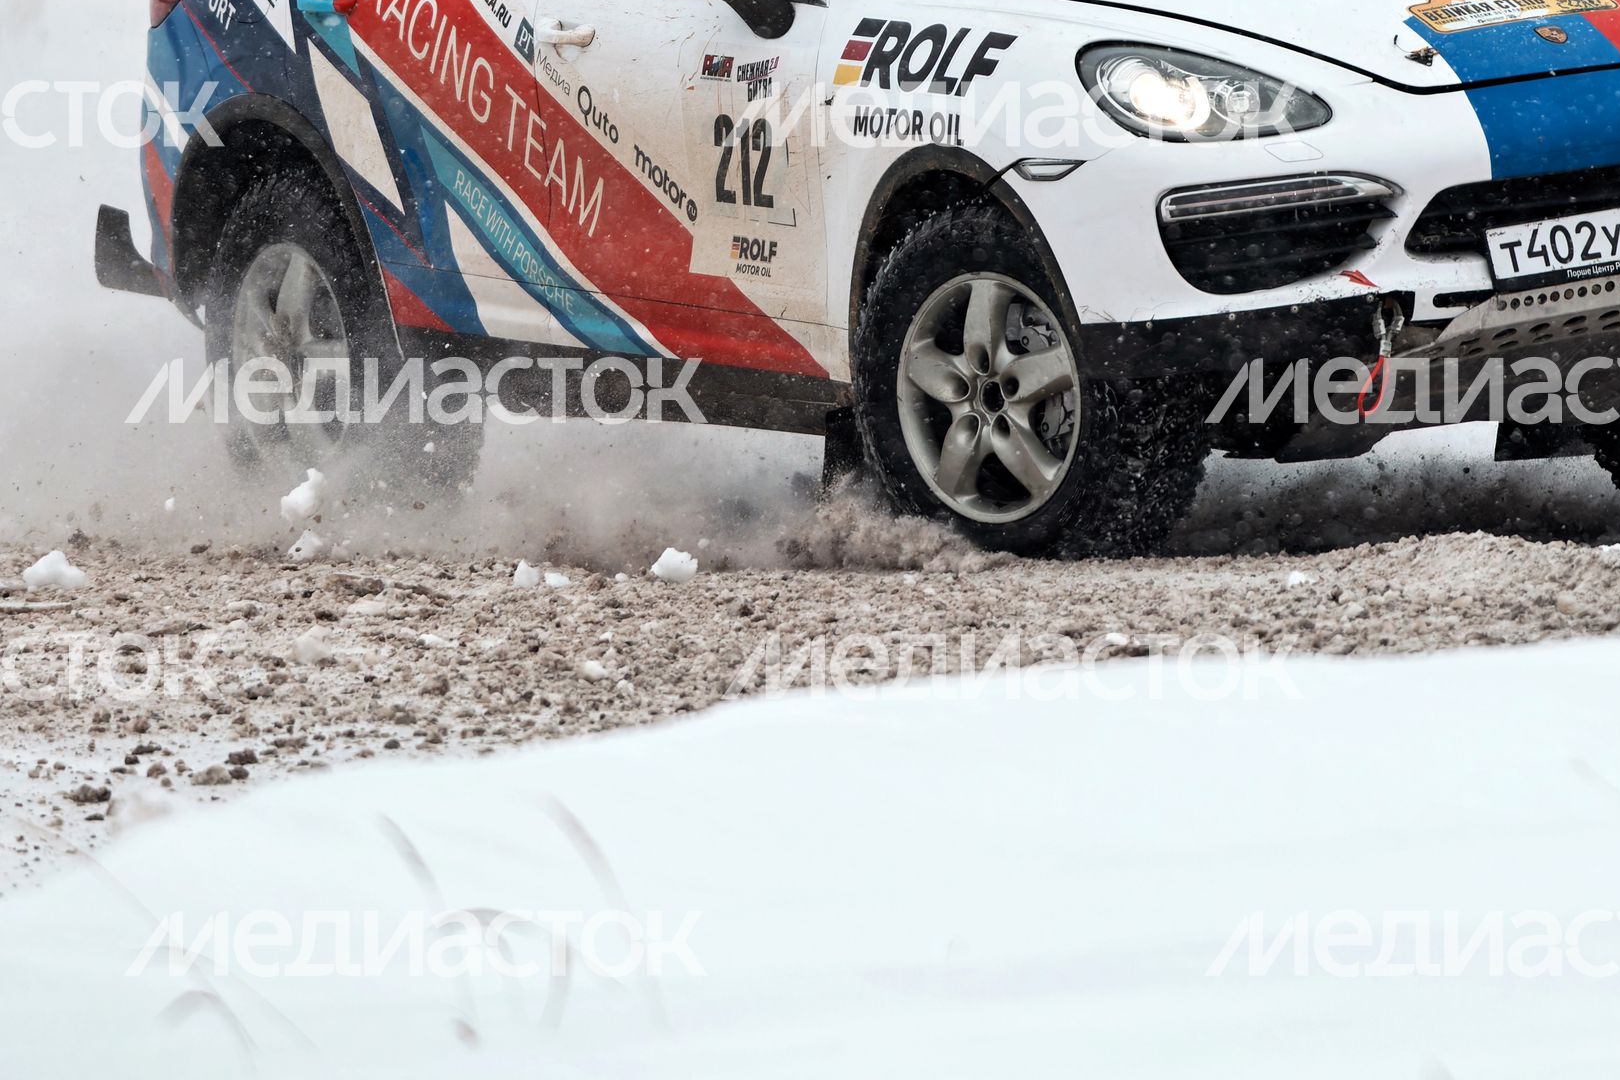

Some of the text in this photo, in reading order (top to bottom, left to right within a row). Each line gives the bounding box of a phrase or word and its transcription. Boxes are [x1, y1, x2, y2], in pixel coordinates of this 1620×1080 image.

[1422, 1, 1495, 22] ВЕЛИКАЯ
[536, 48, 571, 97] Медиа
[737, 59, 770, 83] СНЕЖНАЯ
[860, 20, 1019, 97] ROLF
[747, 77, 773, 102] БИТВА
[853, 105, 965, 147] MOTOR OIL
[504, 84, 604, 238] TEAM
[714, 114, 775, 208] 212
[453, 169, 575, 315] RACE WITH PORSCHE
[739, 237, 778, 263] ROLF
[736, 262, 772, 278] MOTOR OIL
[1566, 267, 1592, 279] Порше
[1592, 263, 1616, 276] Центр
